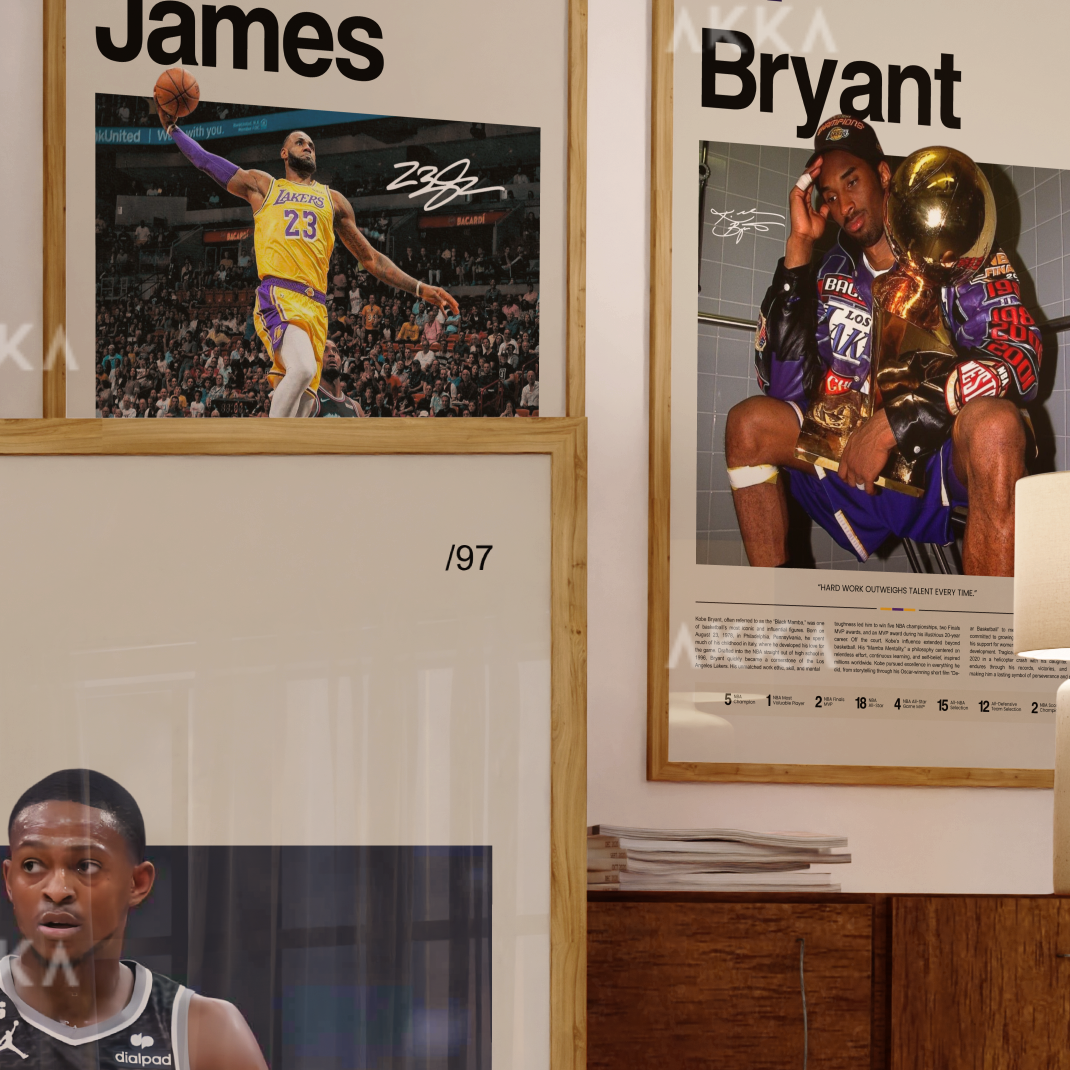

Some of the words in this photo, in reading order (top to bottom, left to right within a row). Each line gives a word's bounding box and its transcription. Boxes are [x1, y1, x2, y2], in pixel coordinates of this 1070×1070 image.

[95, 0, 385, 82] James
[701, 27, 962, 139] Bryant
[185, 125, 204, 138] with
[206, 125, 225, 140] you.
[283, 209, 319, 242] 23
[445, 544, 493, 572] /97
[841, 583, 863, 593] WORK
[865, 584, 907, 594] OUTWEIGHS
[909, 586, 933, 595] TALENT
[934, 588, 955, 596] EVERY
[724, 693, 731, 705] 5
[766, 694, 773, 706] 1
[814, 695, 824, 707] 2
[855, 696, 866, 709] 18
[893, 697, 903, 710] 4
[937, 699, 948, 711] 15
[978, 700, 989, 712] 12
[1031, 701, 1040, 713] 2
[115, 1050, 172, 1068] dialpad
